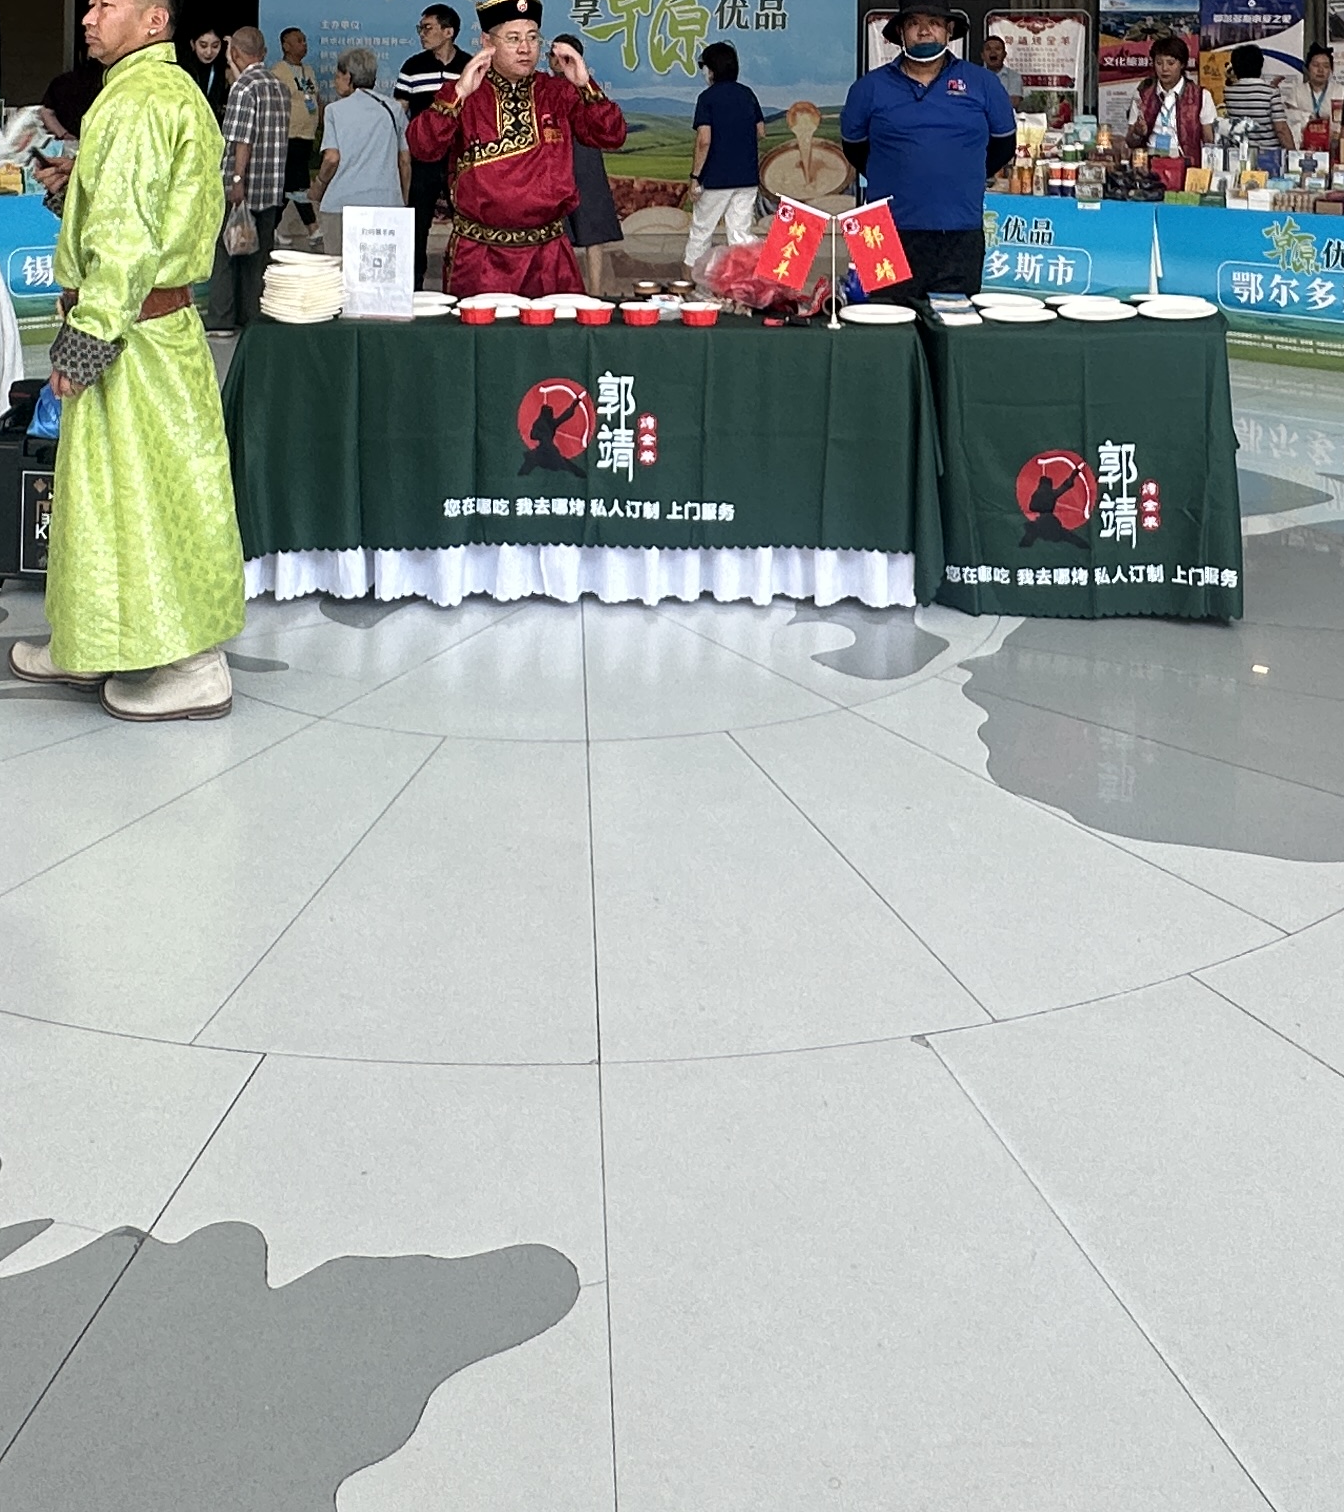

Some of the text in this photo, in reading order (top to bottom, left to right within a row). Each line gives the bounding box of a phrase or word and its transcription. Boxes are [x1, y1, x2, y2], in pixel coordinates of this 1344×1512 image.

[22, 254, 54, 287] 锡
[984, 250, 1077, 286] 多斯市
[596, 370, 637, 483] 郭靖
[589, 498, 660, 521] 私人订制
[666, 500, 736, 522] 上门服务
[1098, 438, 1139, 550] 郭靖
[1094, 563, 1164, 586] 私人订制
[1170, 564, 1239, 589] 上门服务
